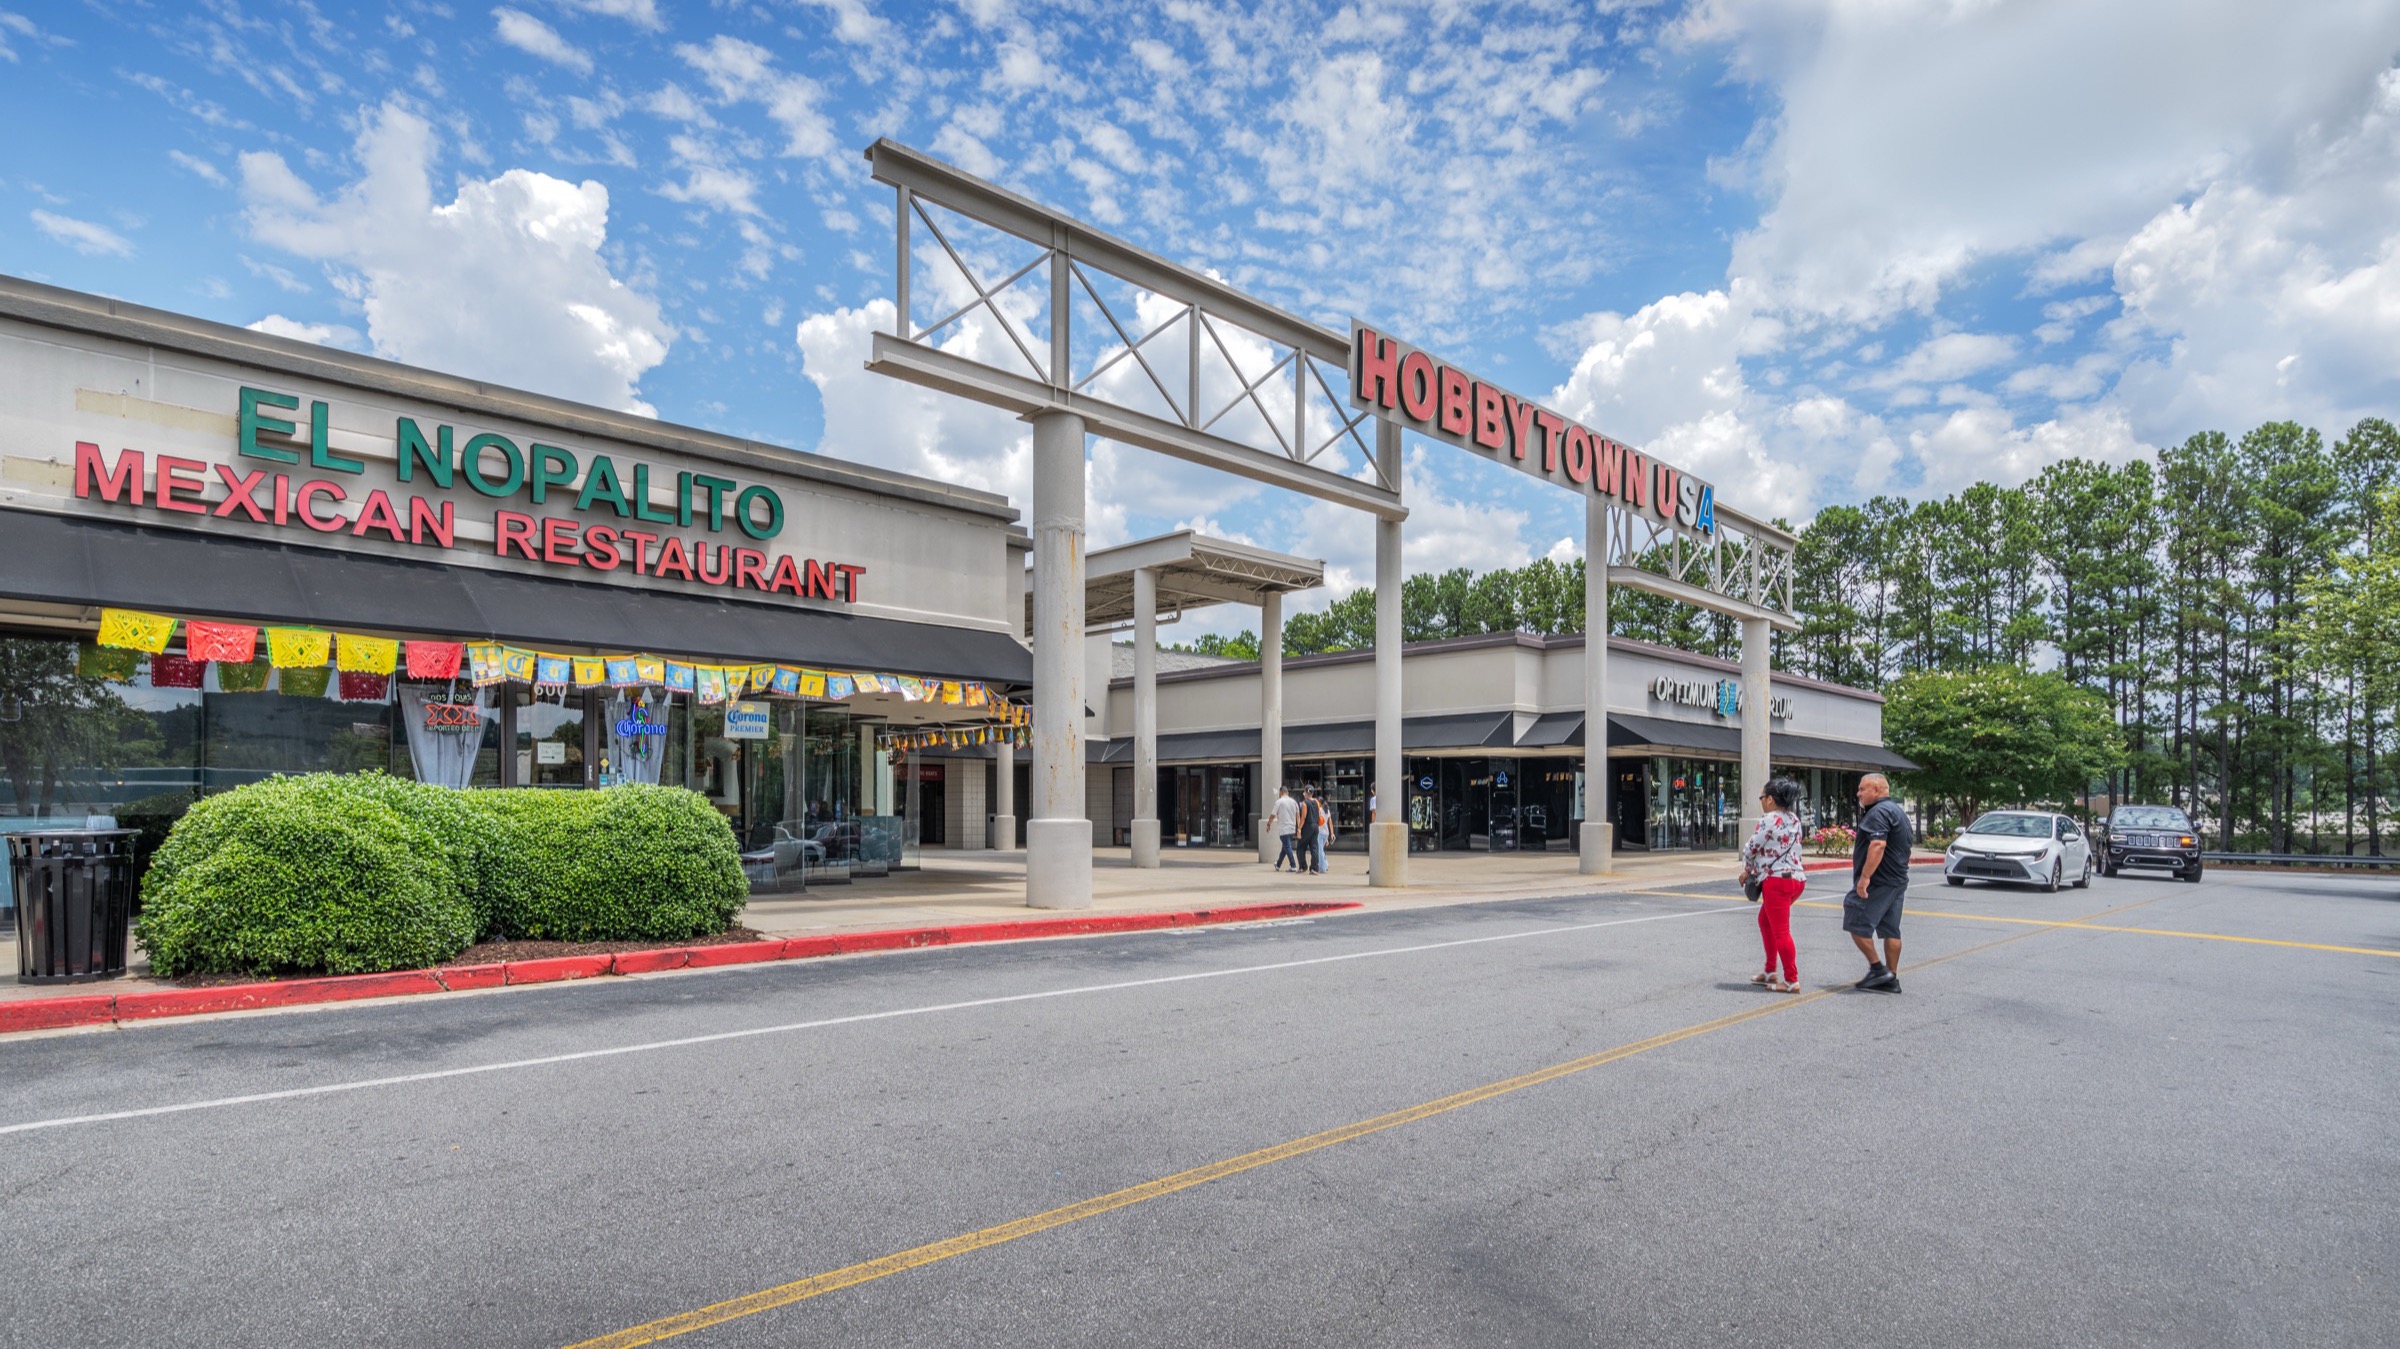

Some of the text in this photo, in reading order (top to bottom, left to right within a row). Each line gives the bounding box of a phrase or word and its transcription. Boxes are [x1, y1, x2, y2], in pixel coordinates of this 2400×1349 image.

[1357, 328, 1714, 536] HOBBYTOWN USA
[238, 386, 785, 541] EL NOPALITO
[75, 441, 866, 604] MEXICAN RESTAURANT
[534, 681, 567, 696] 600
[1654, 675, 1718, 709] OPTIMUM
[425, 703, 479, 725] XX
[727, 709, 767, 726] Corona
[616, 720, 666, 738] Corona
[730, 724, 764, 734] PREMIER
